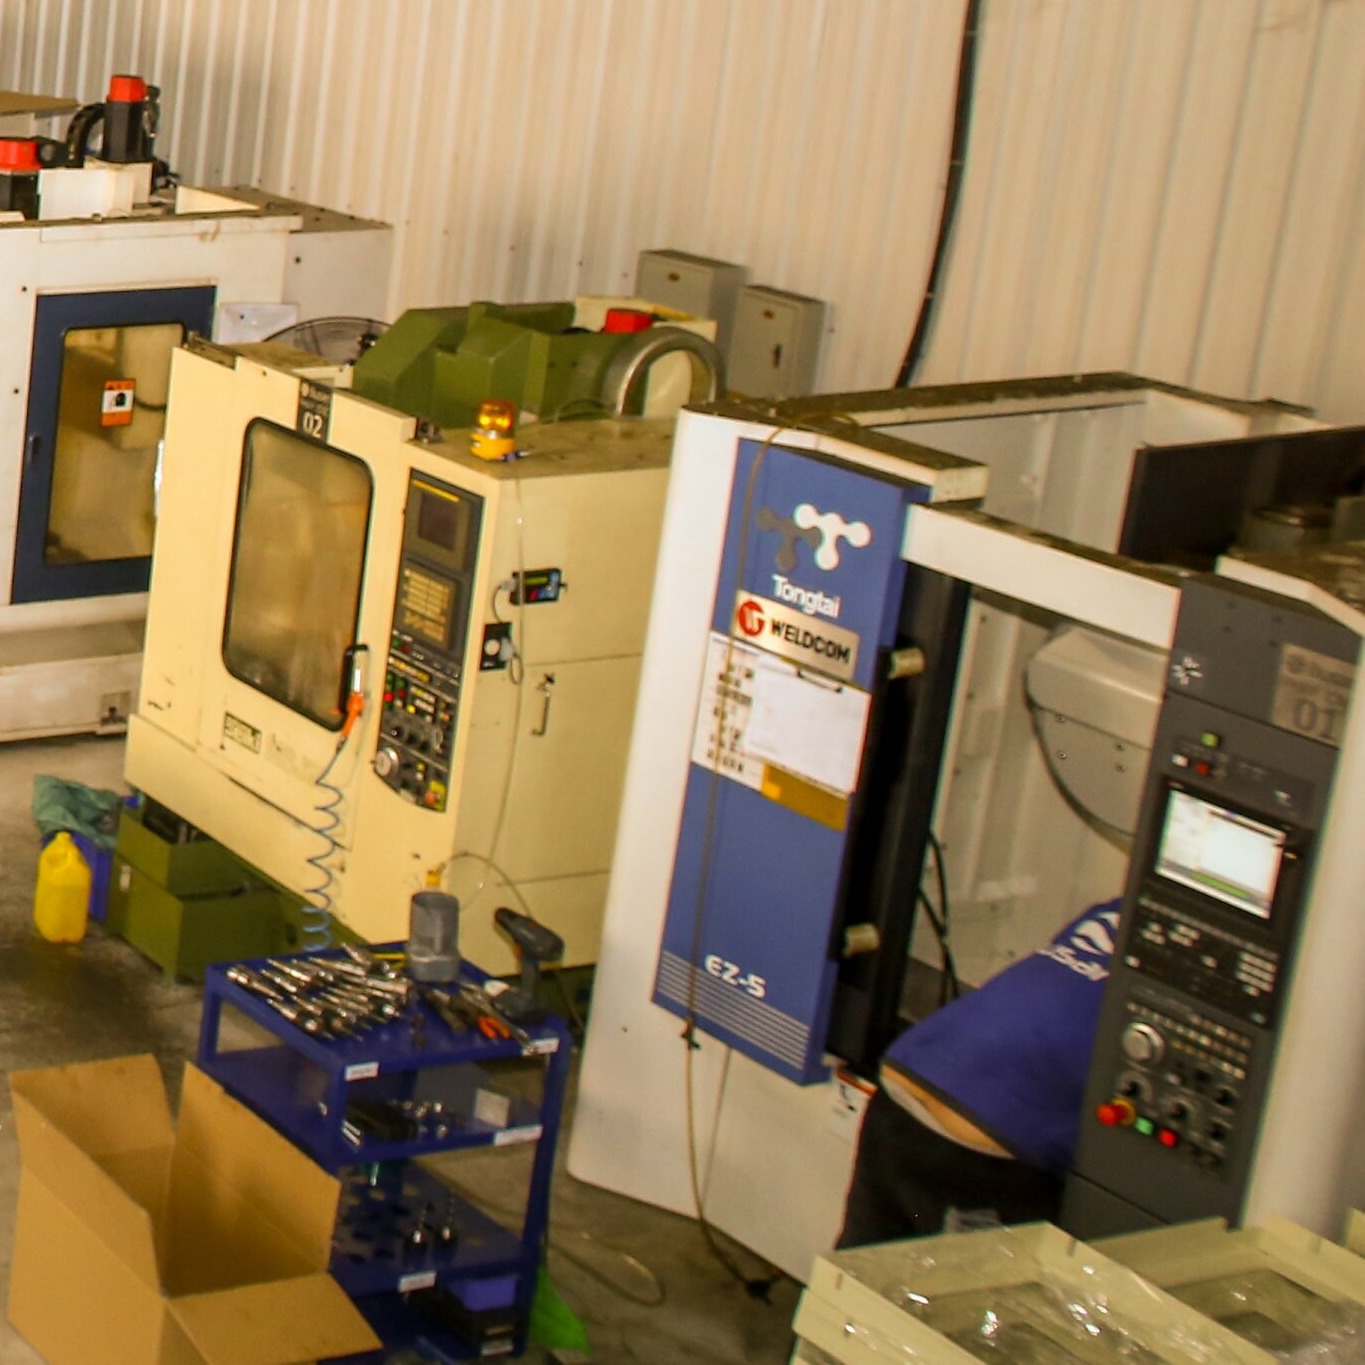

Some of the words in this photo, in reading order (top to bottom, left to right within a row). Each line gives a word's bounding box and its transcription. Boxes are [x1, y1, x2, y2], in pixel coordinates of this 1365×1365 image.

[303, 411, 323, 439] 02
[772, 573, 841, 618] Tongtai
[771, 618, 850, 664] WELDCOM
[1293, 697, 1337, 742] 01
